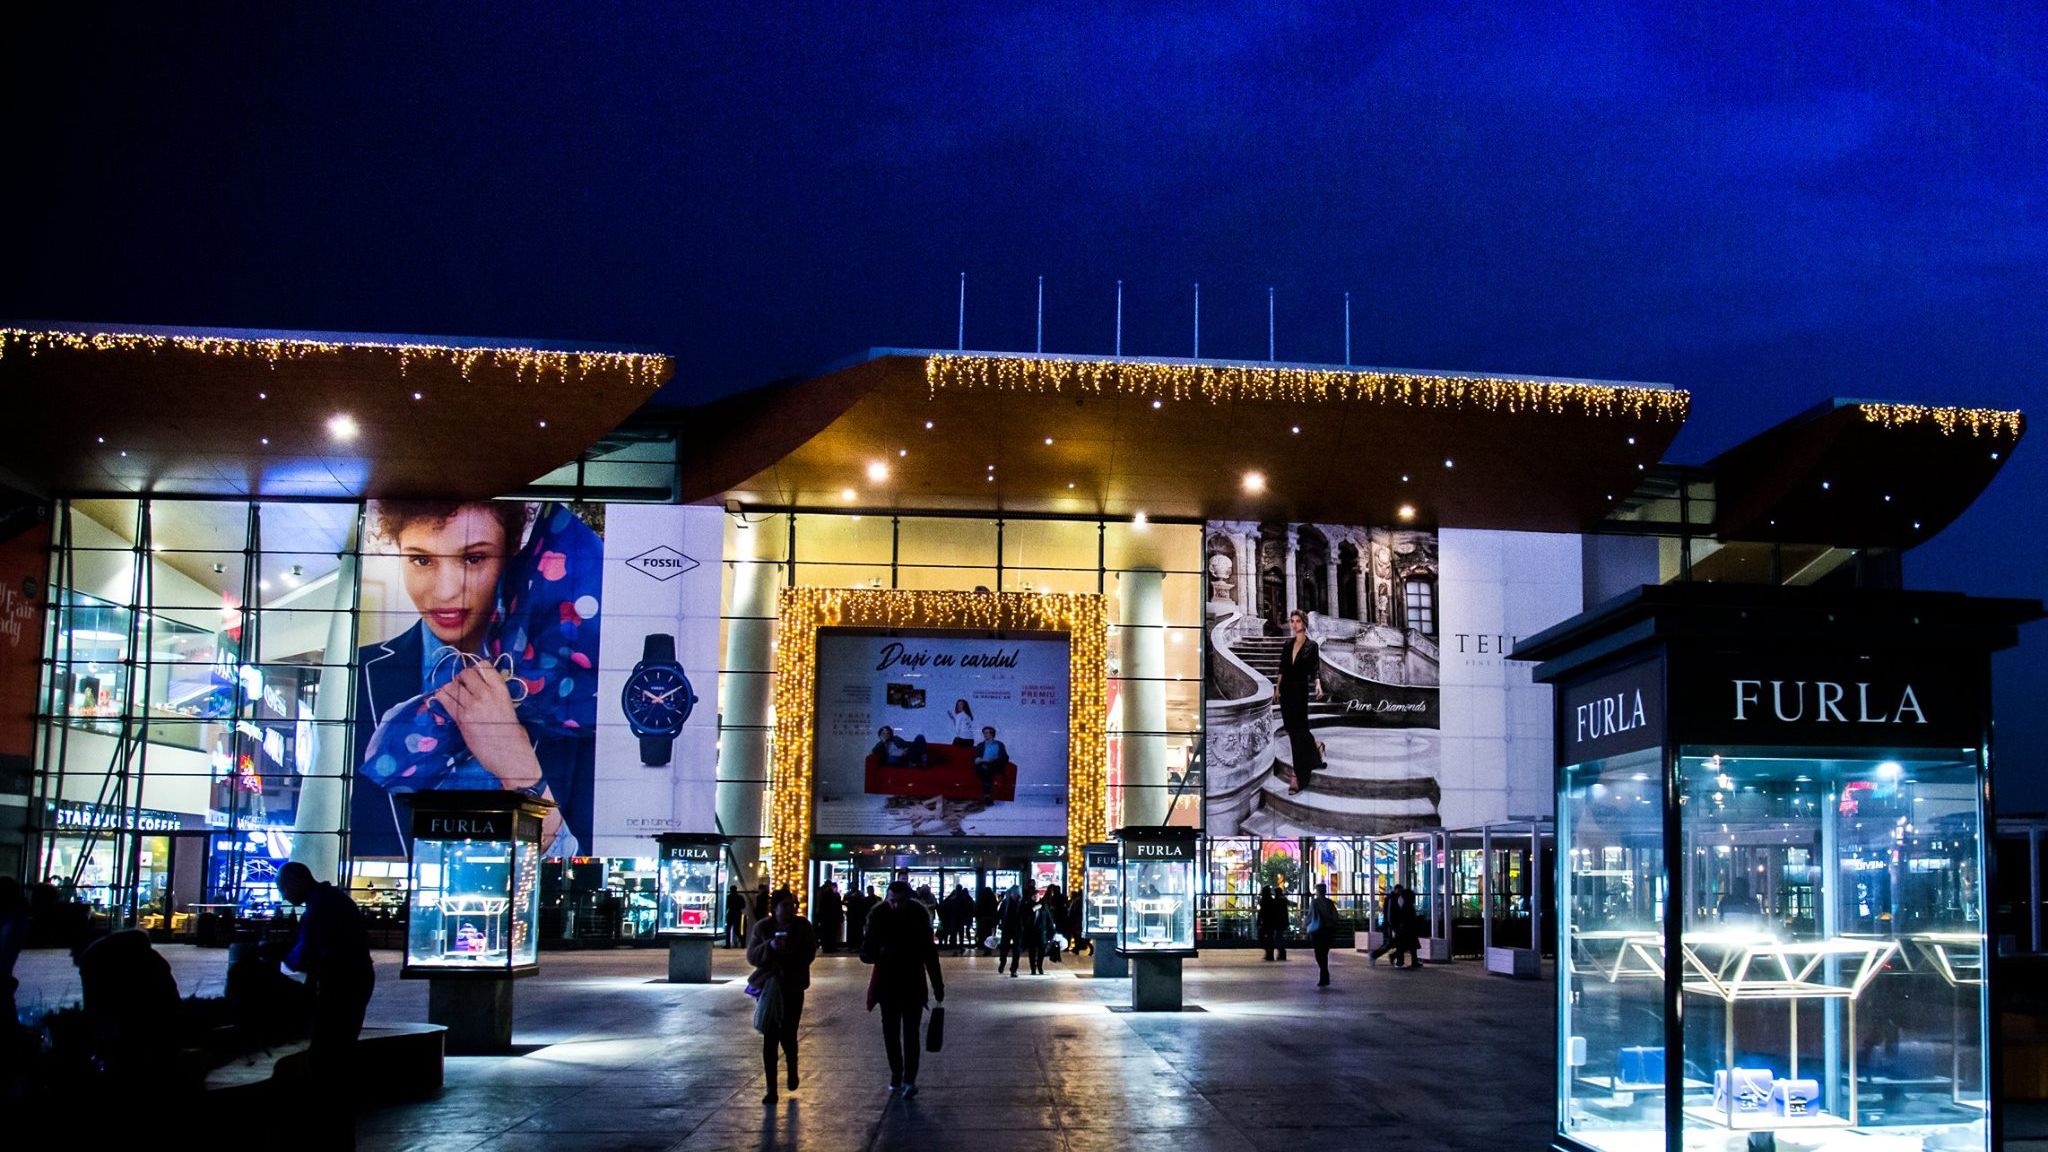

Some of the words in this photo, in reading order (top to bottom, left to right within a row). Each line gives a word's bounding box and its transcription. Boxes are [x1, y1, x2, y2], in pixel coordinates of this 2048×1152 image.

[643, 557, 683, 569] FOSSIL
[934, 653, 956, 668] cu
[960, 648, 1020, 669] cardul
[1021, 690, 1055, 698] PREMIU
[1344, 698, 1371, 713] Pure
[1373, 698, 1427, 713] Diamonds
[1733, 679, 1929, 724] FURLA
[1576, 687, 1647, 743] FURLA
[138, 817, 182, 831] COFFEE
[430, 818, 496, 834] FURLA
[671, 848, 709, 859] FURLA
[1137, 845, 1183, 856] FURLA
[1096, 856, 1118, 865] FUR
